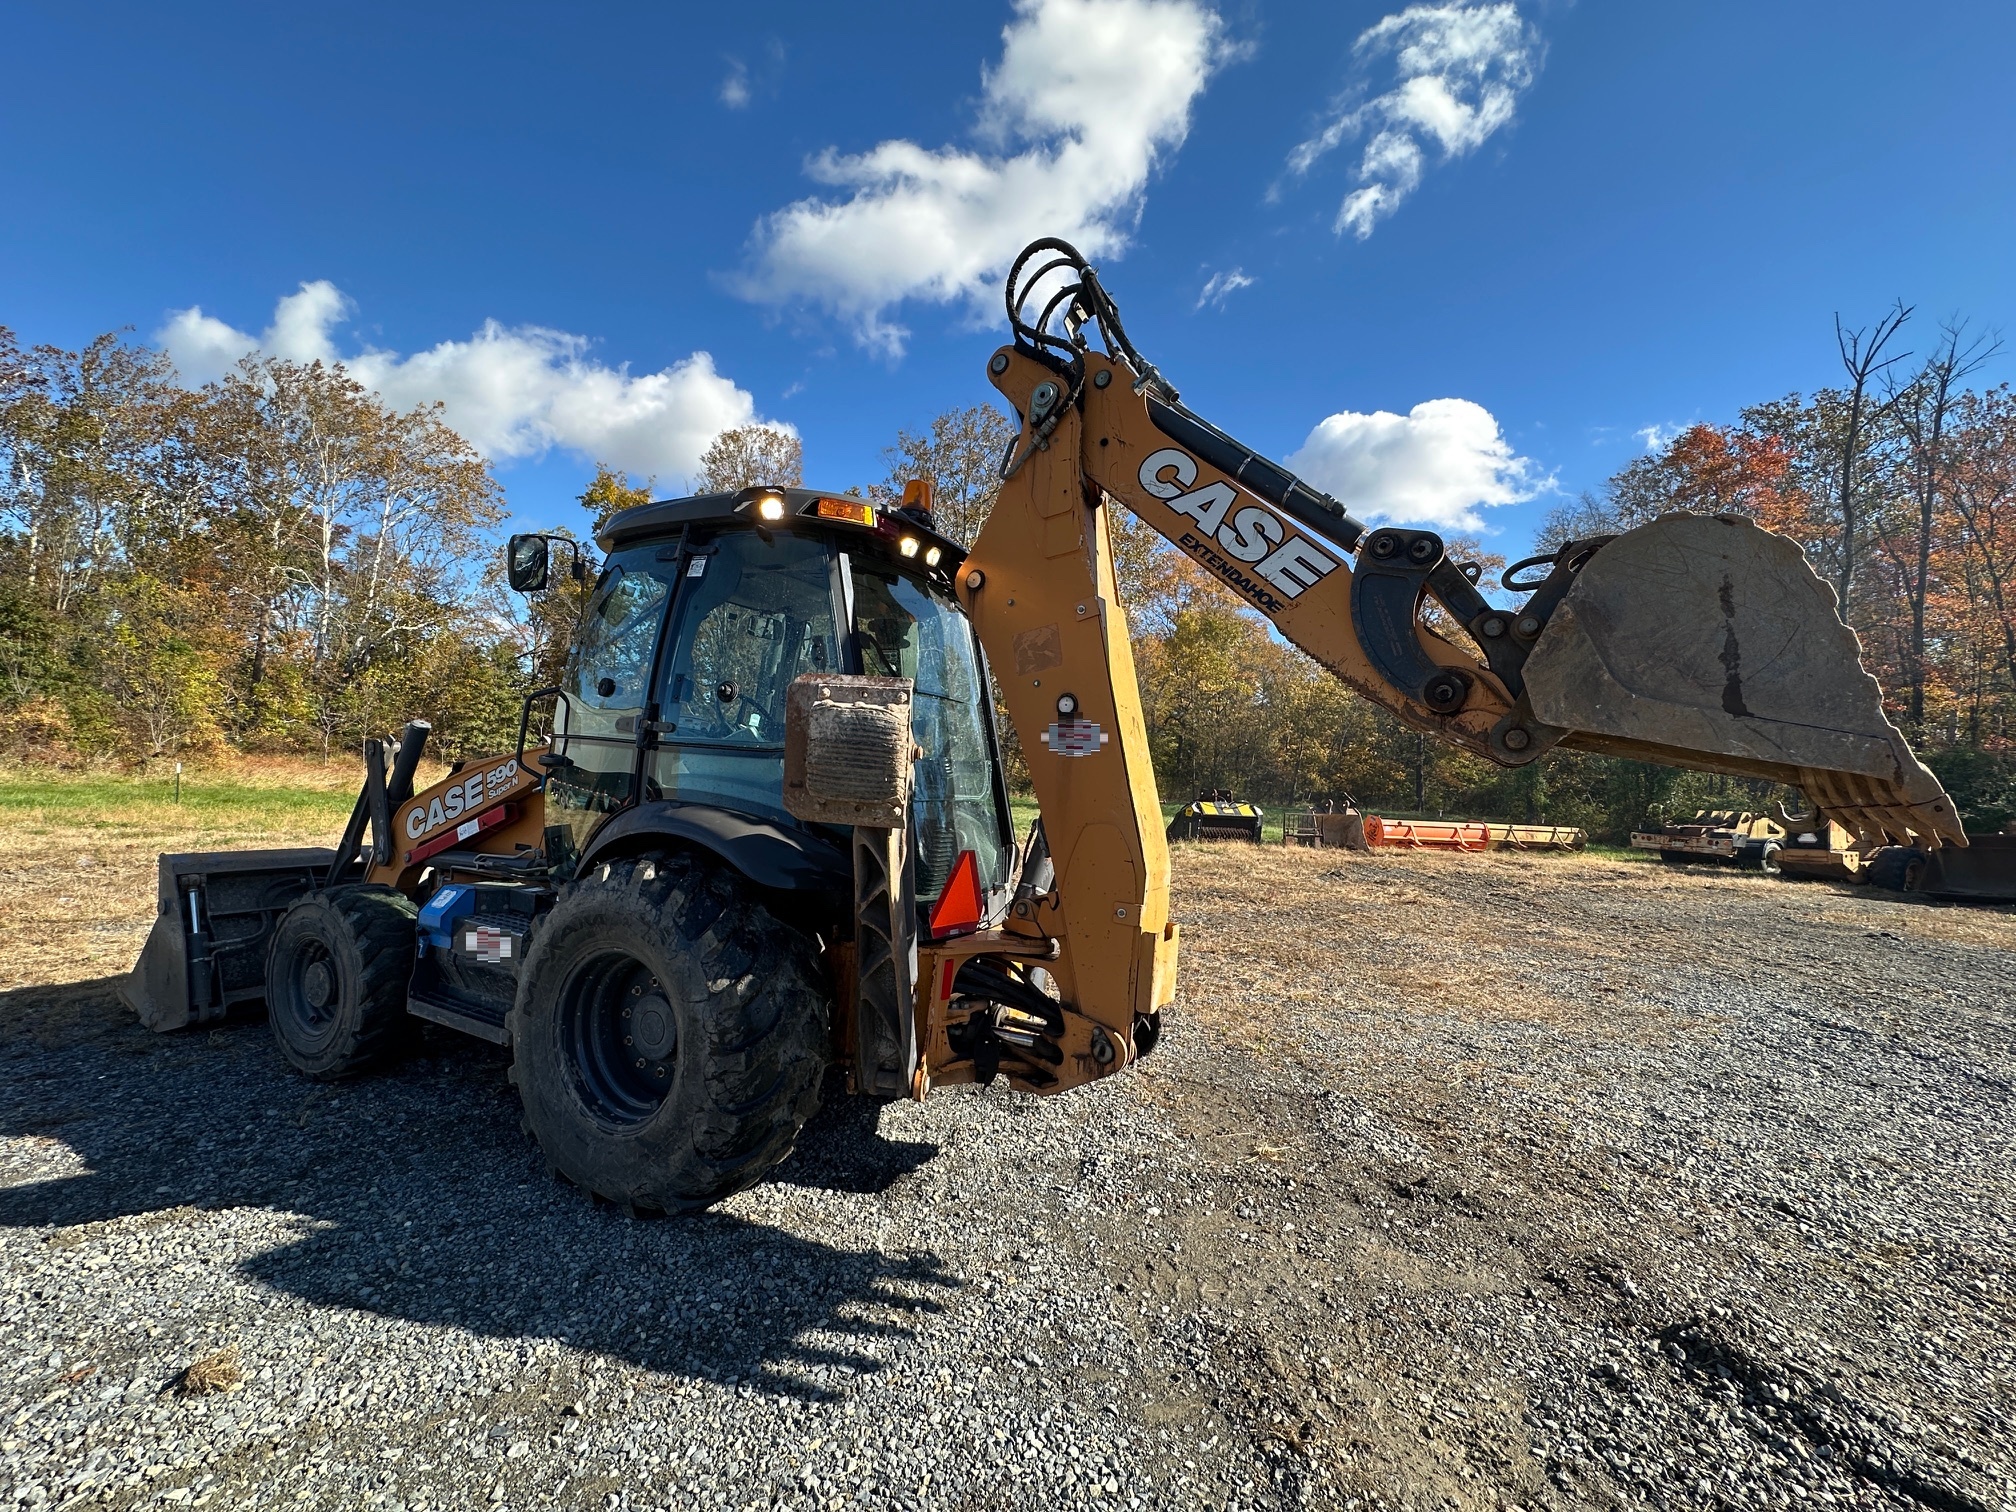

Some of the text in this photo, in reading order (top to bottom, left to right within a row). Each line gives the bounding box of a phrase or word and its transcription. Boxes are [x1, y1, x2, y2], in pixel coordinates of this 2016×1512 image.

[1138, 448, 1341, 600] CASE
[1178, 533, 1285, 613] EXTENDAHOE
[406, 771, 484, 840] CASE
[486, 758, 518, 788] 590
[488, 775, 518, 798] Super N
